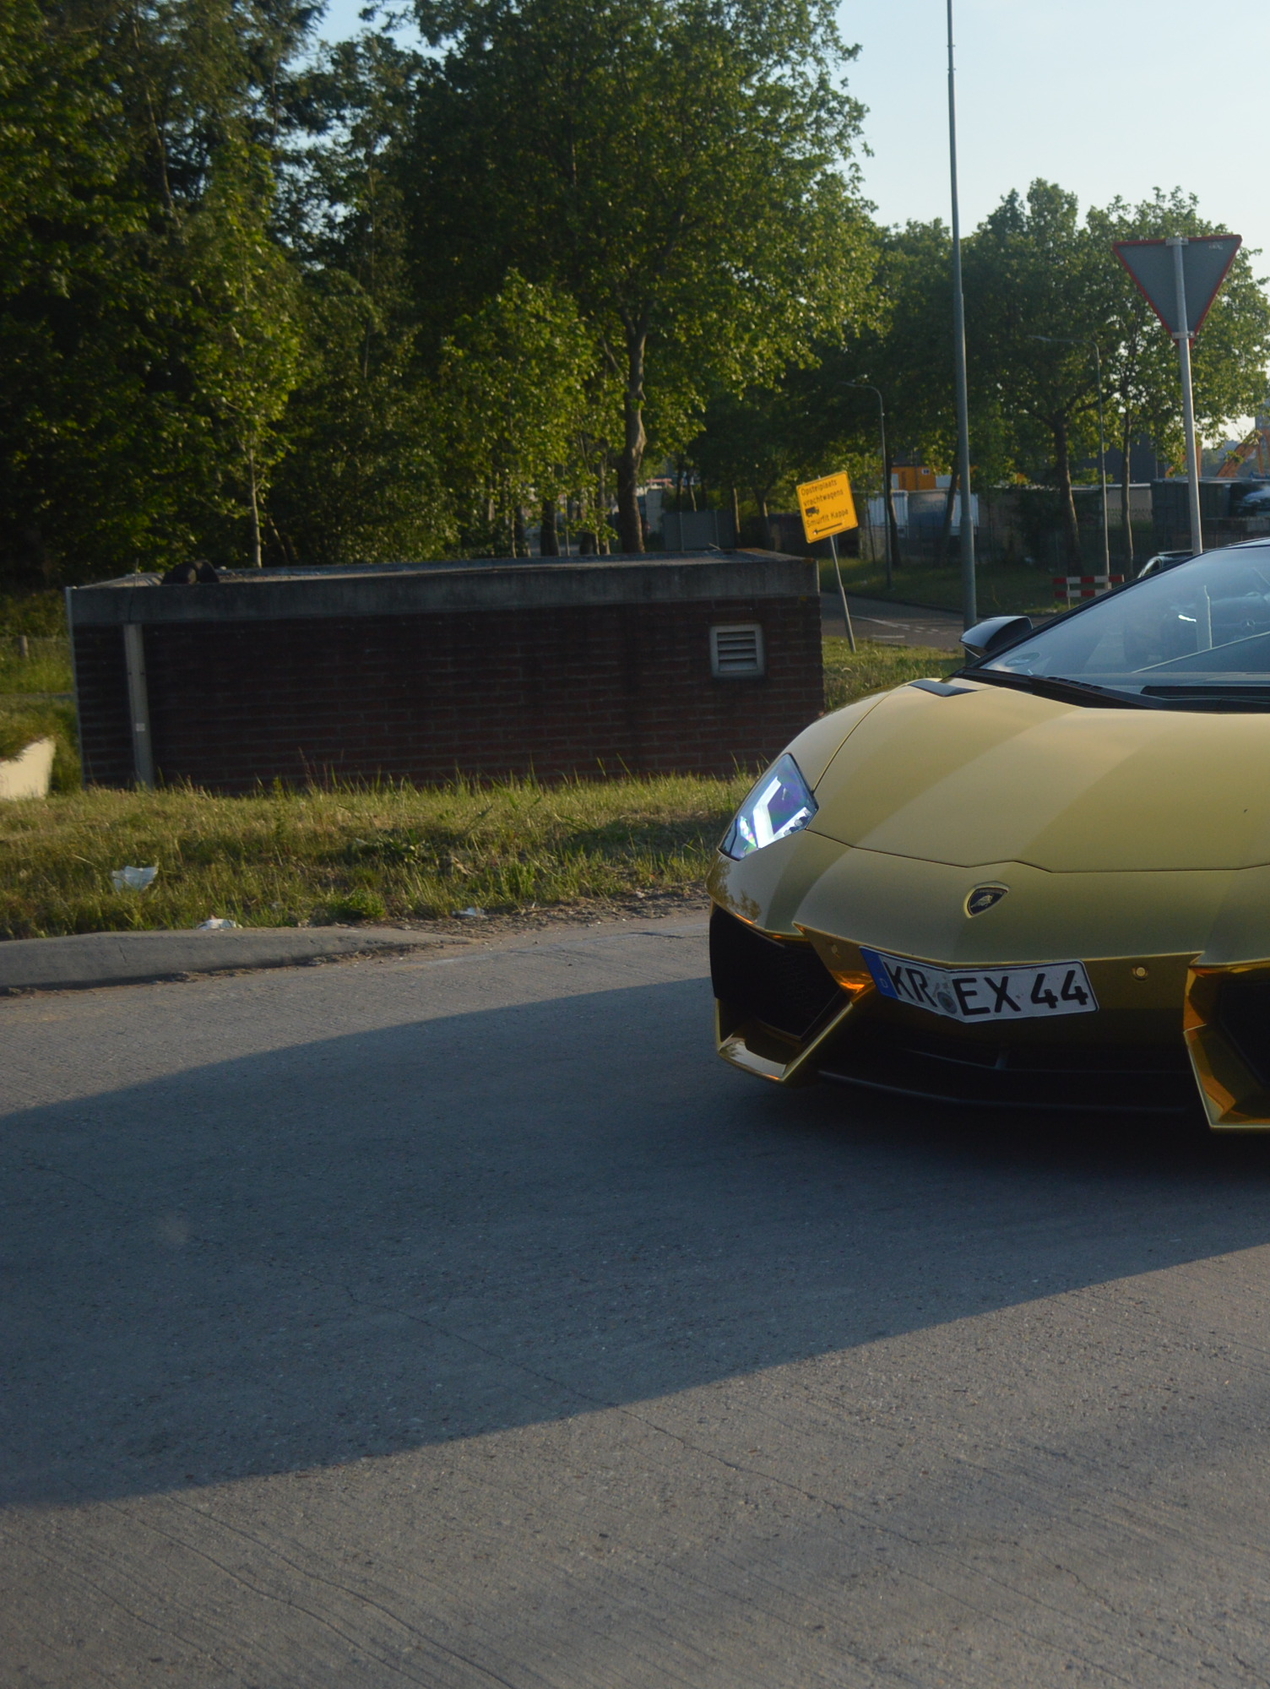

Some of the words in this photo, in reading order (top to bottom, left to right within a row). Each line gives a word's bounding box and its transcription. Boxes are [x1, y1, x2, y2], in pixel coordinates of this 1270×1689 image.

[801, 480, 837, 496] Opstelplaats
[803, 489, 844, 506] vrachtwagens
[884, 961, 938, 1008] KR
[952, 976, 1022, 1016] EX
[1030, 969, 1089, 1009] 44
